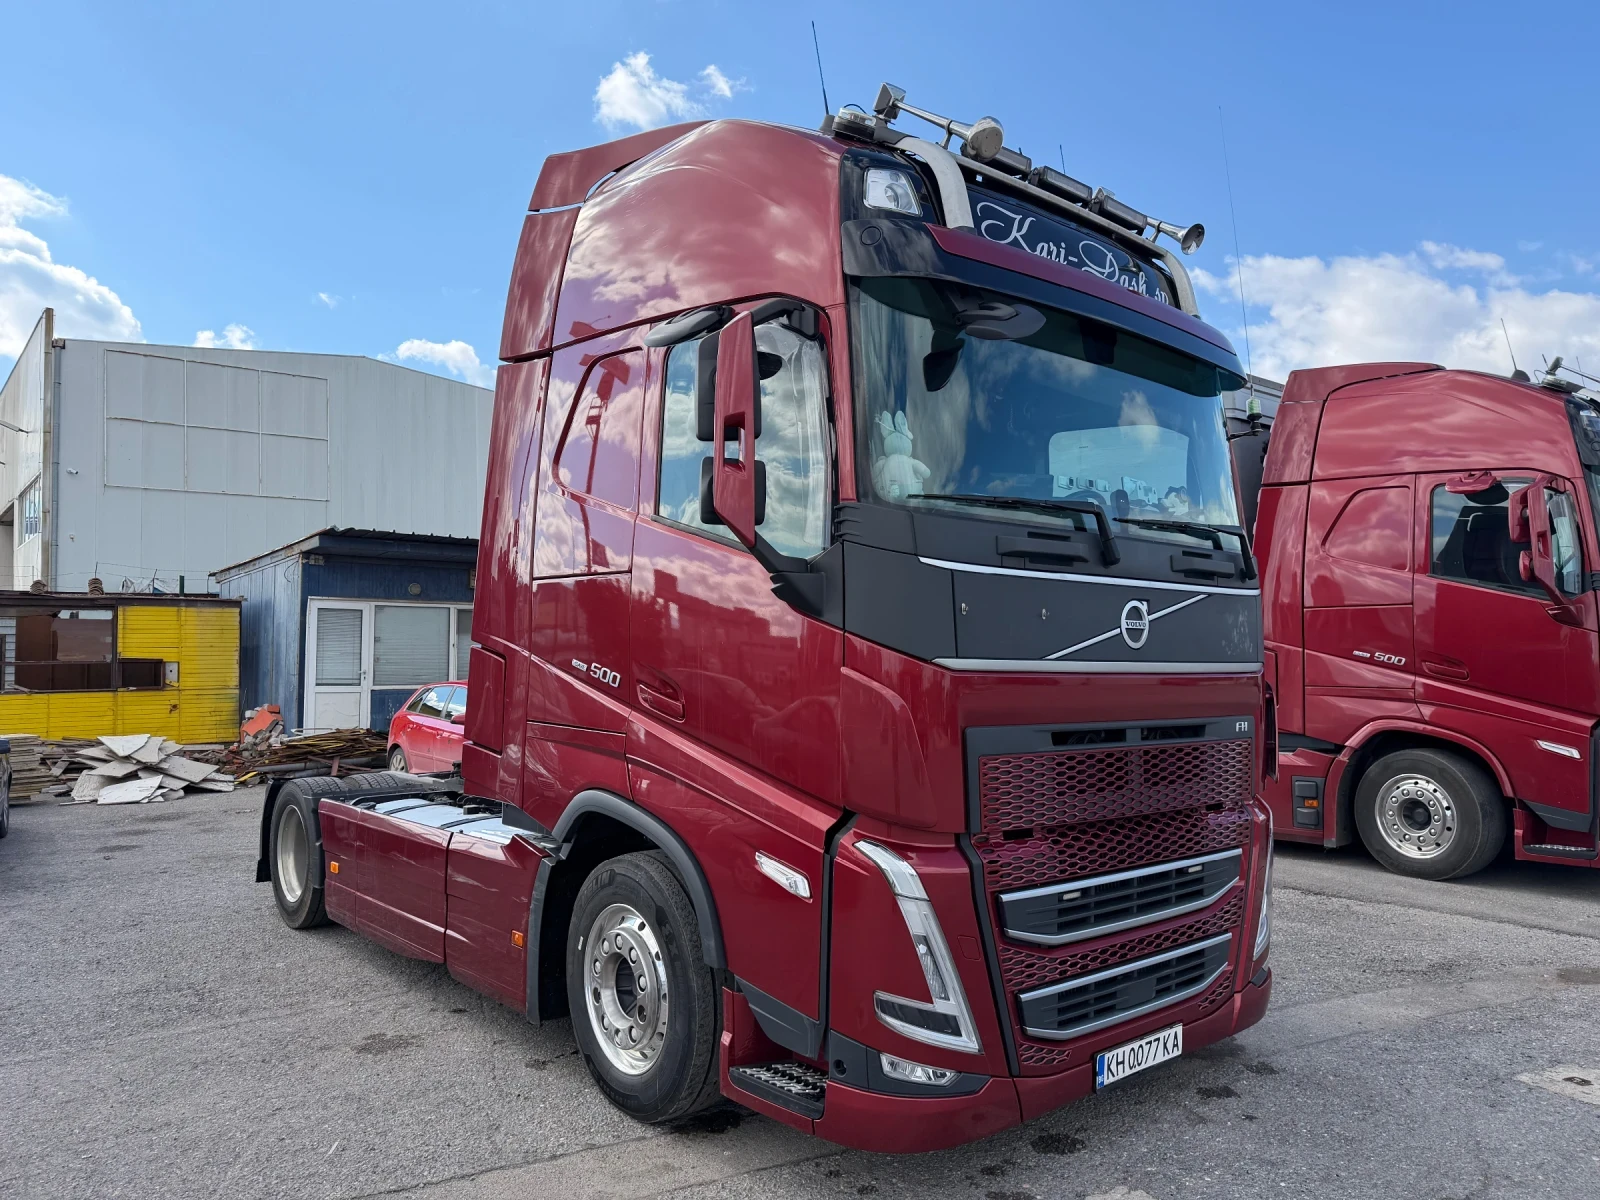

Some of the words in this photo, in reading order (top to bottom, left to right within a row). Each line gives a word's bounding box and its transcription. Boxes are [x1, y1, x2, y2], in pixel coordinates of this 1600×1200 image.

[1374, 652, 1406, 666] 500
[590, 662, 621, 688] 500
[1235, 721, 1248, 732] FH
